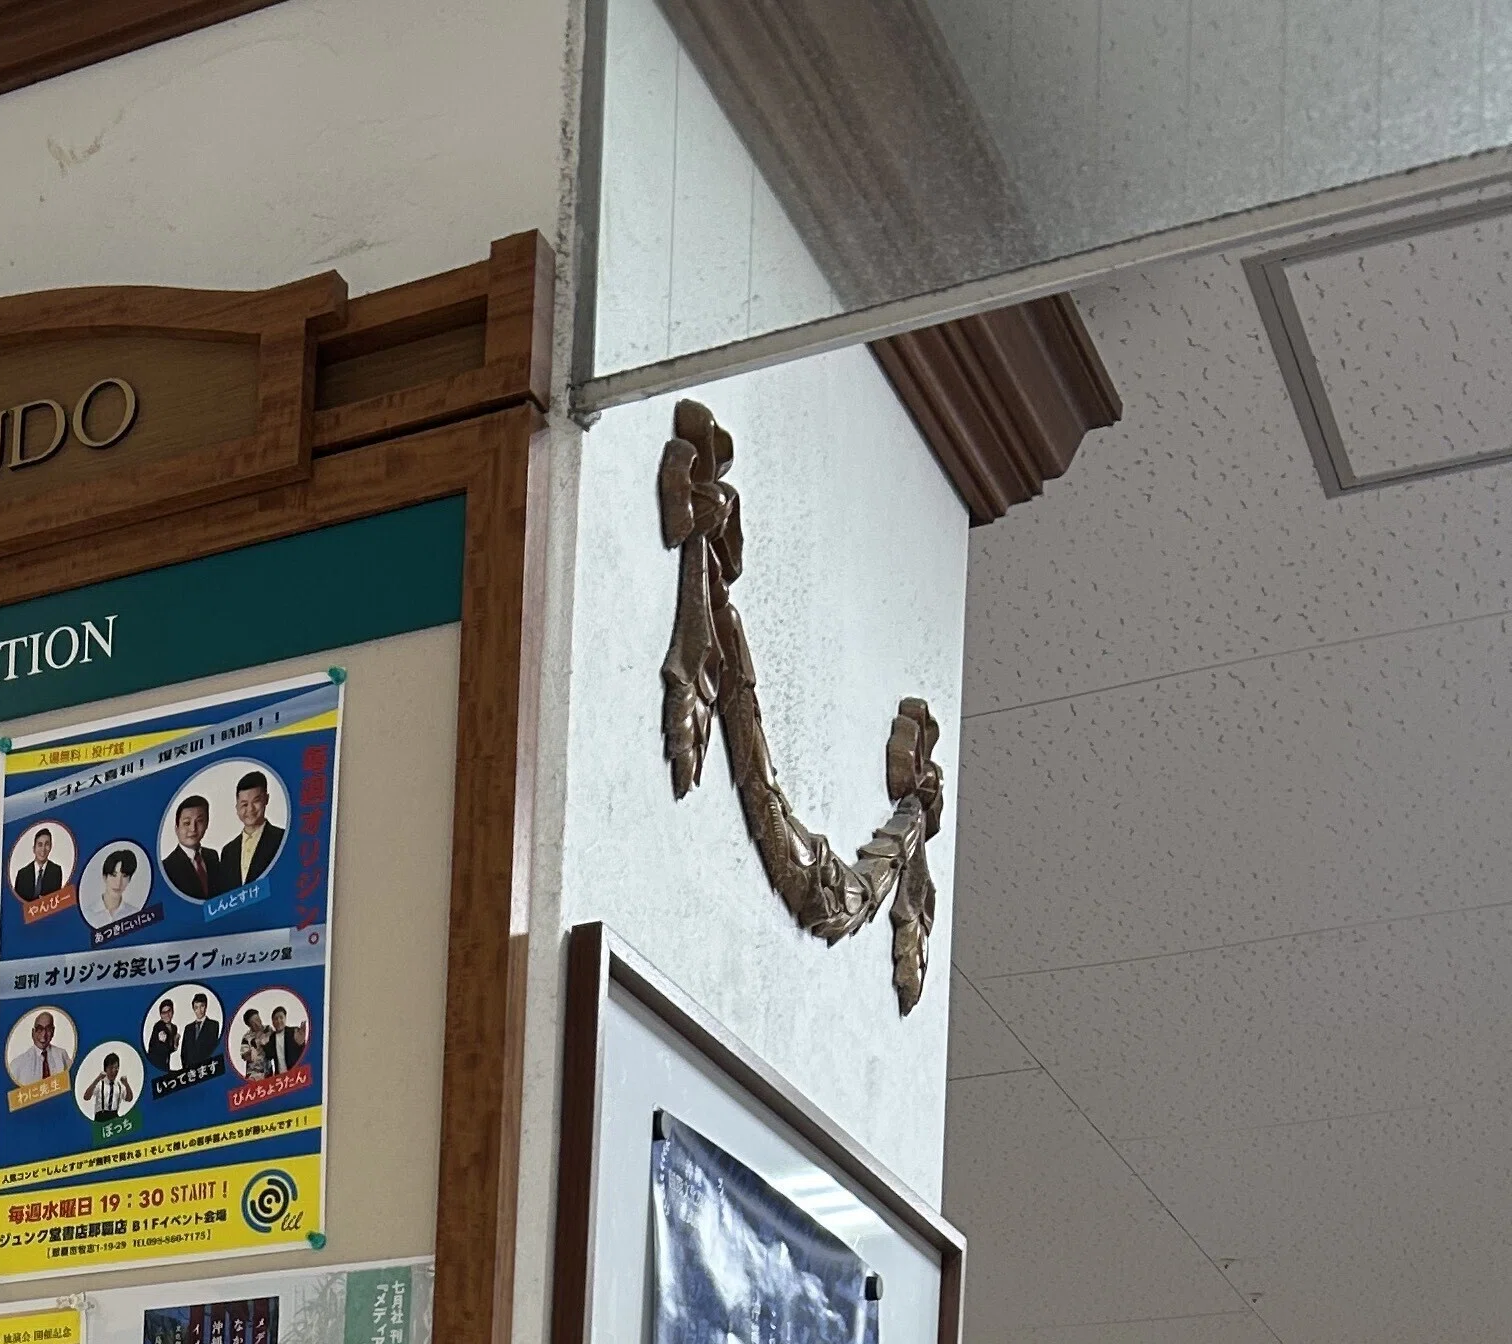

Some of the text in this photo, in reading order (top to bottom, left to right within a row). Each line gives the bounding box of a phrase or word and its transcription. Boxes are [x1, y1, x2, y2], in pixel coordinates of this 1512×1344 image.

[207, 885, 261, 916] しんとすけ
[44, 947, 292, 986] オリジンお笑いライブ ジュンク堂
[17, 1079, 60, 1103] わに先生
[156, 1061, 219, 1094] いってきます
[8, 1197, 93, 1224] 毎週水曜日
[0, 1219, 127, 1248] ジュンク堂書店那覇店
[390, 1280, 406, 1323] 七月社
